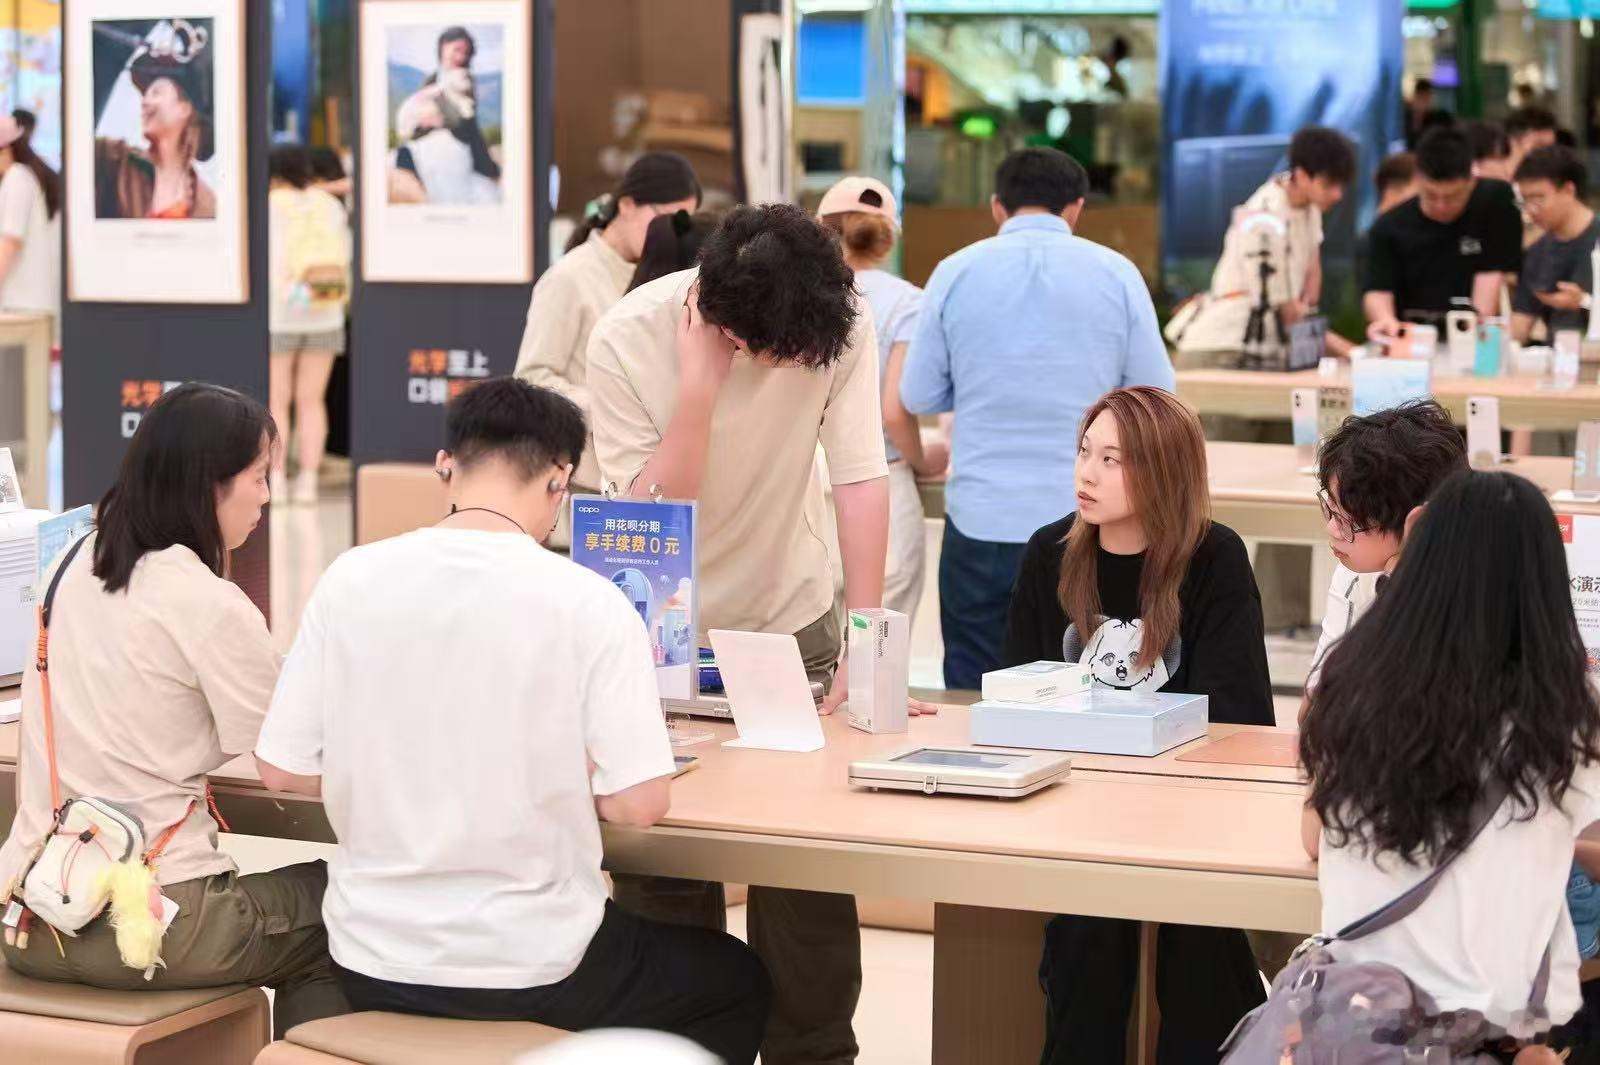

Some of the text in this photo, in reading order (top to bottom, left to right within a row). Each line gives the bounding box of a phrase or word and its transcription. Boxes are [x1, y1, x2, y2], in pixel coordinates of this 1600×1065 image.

[605, 518, 660, 533] 用花呗分期
